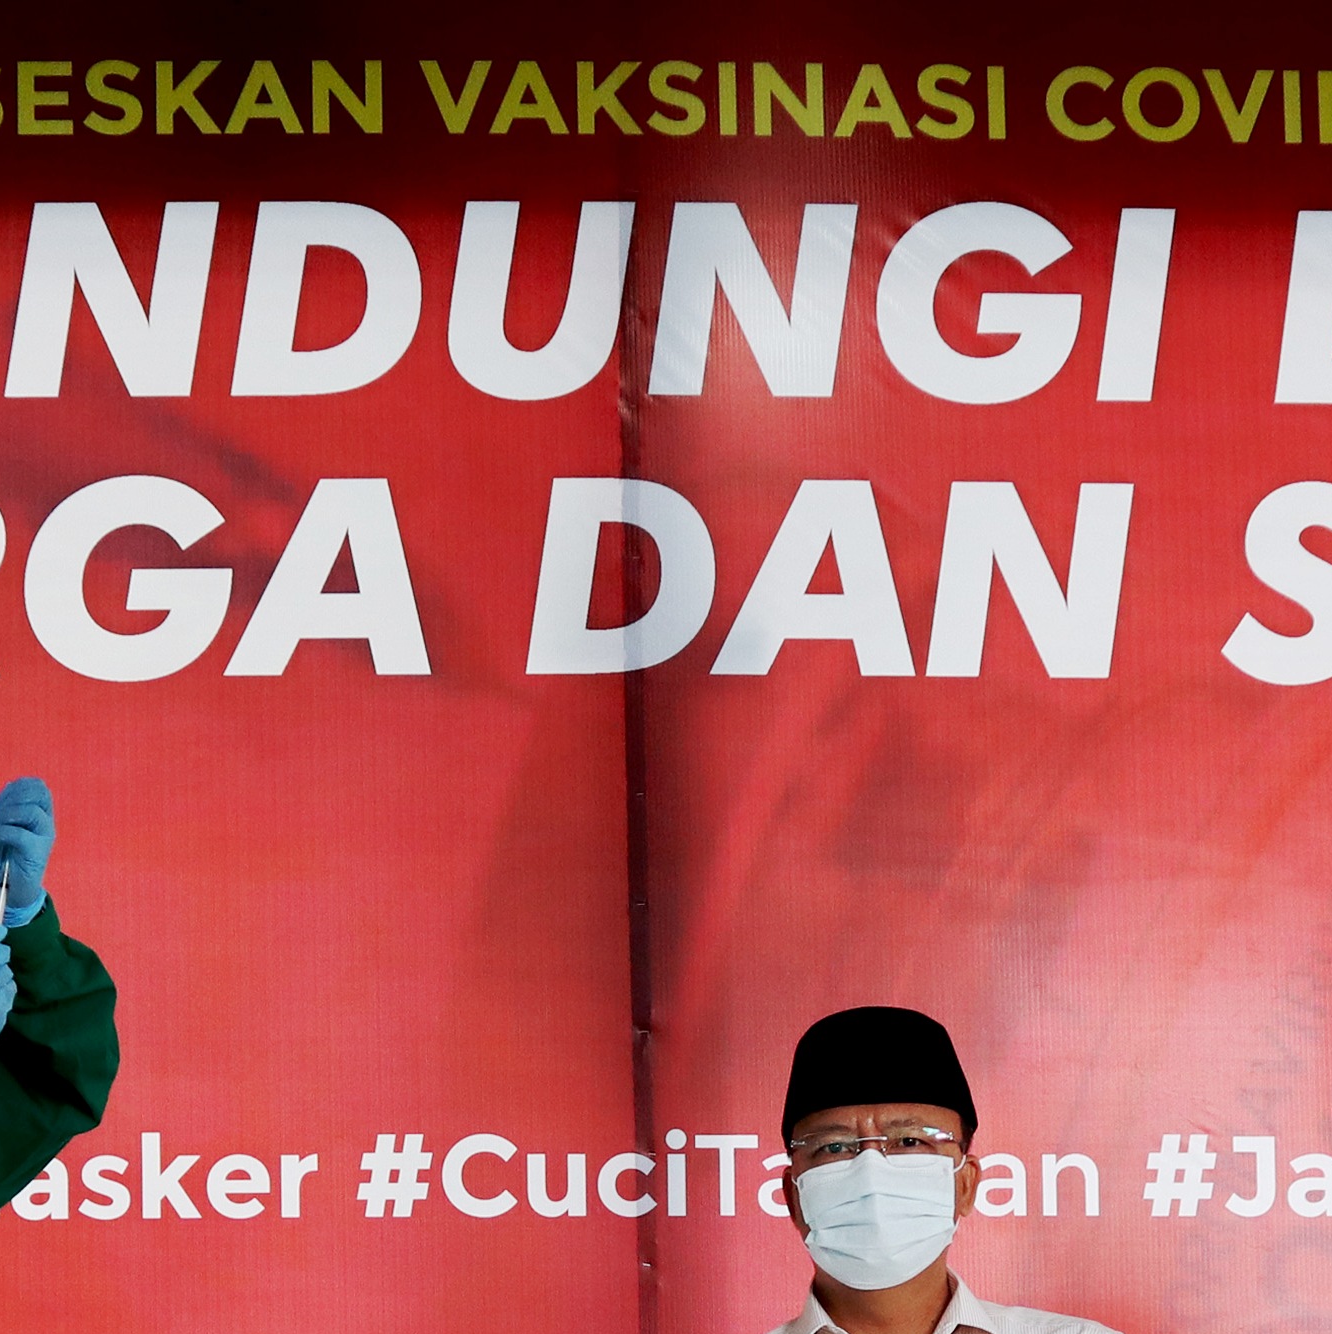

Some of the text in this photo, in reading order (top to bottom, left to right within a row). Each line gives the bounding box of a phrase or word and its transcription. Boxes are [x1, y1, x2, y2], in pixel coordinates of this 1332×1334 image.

[425, 61, 1005, 139] VAKSINASI
[526, 478, 1133, 678] DAN
[10, 1132, 320, 1221] asker
[357, 1128, 1101, 1219] #CuciTaan
